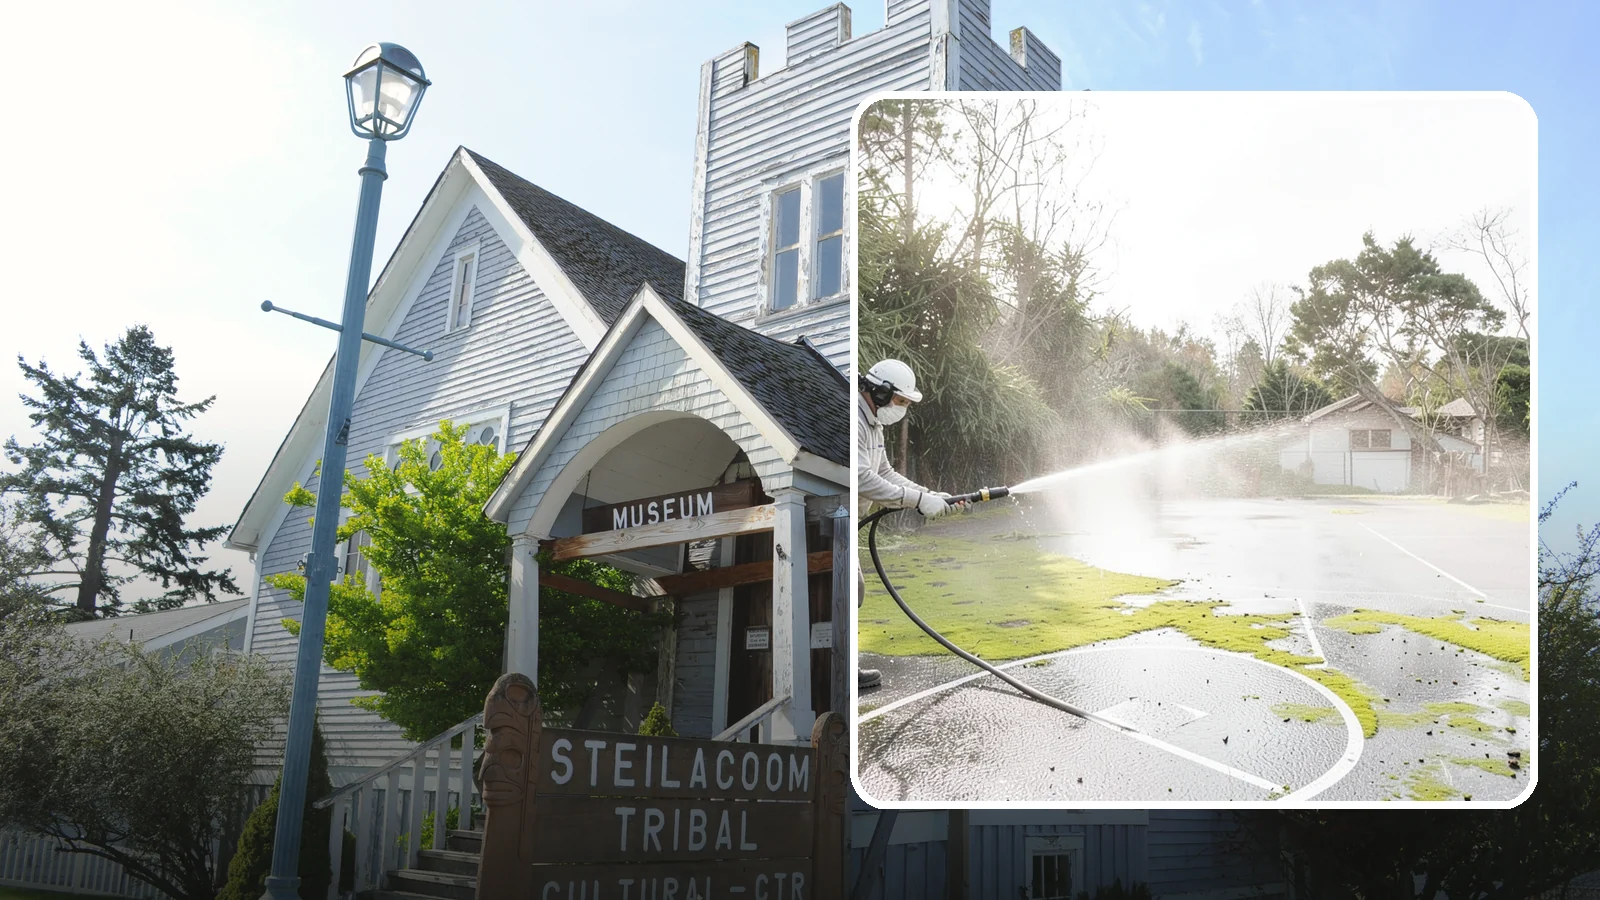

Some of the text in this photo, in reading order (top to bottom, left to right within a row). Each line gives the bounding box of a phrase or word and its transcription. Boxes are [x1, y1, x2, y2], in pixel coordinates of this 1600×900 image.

[613, 491, 713, 531] MUSEUM
[551, 738, 809, 793] STEILACOOM
[615, 806, 757, 852] TRIBAL
